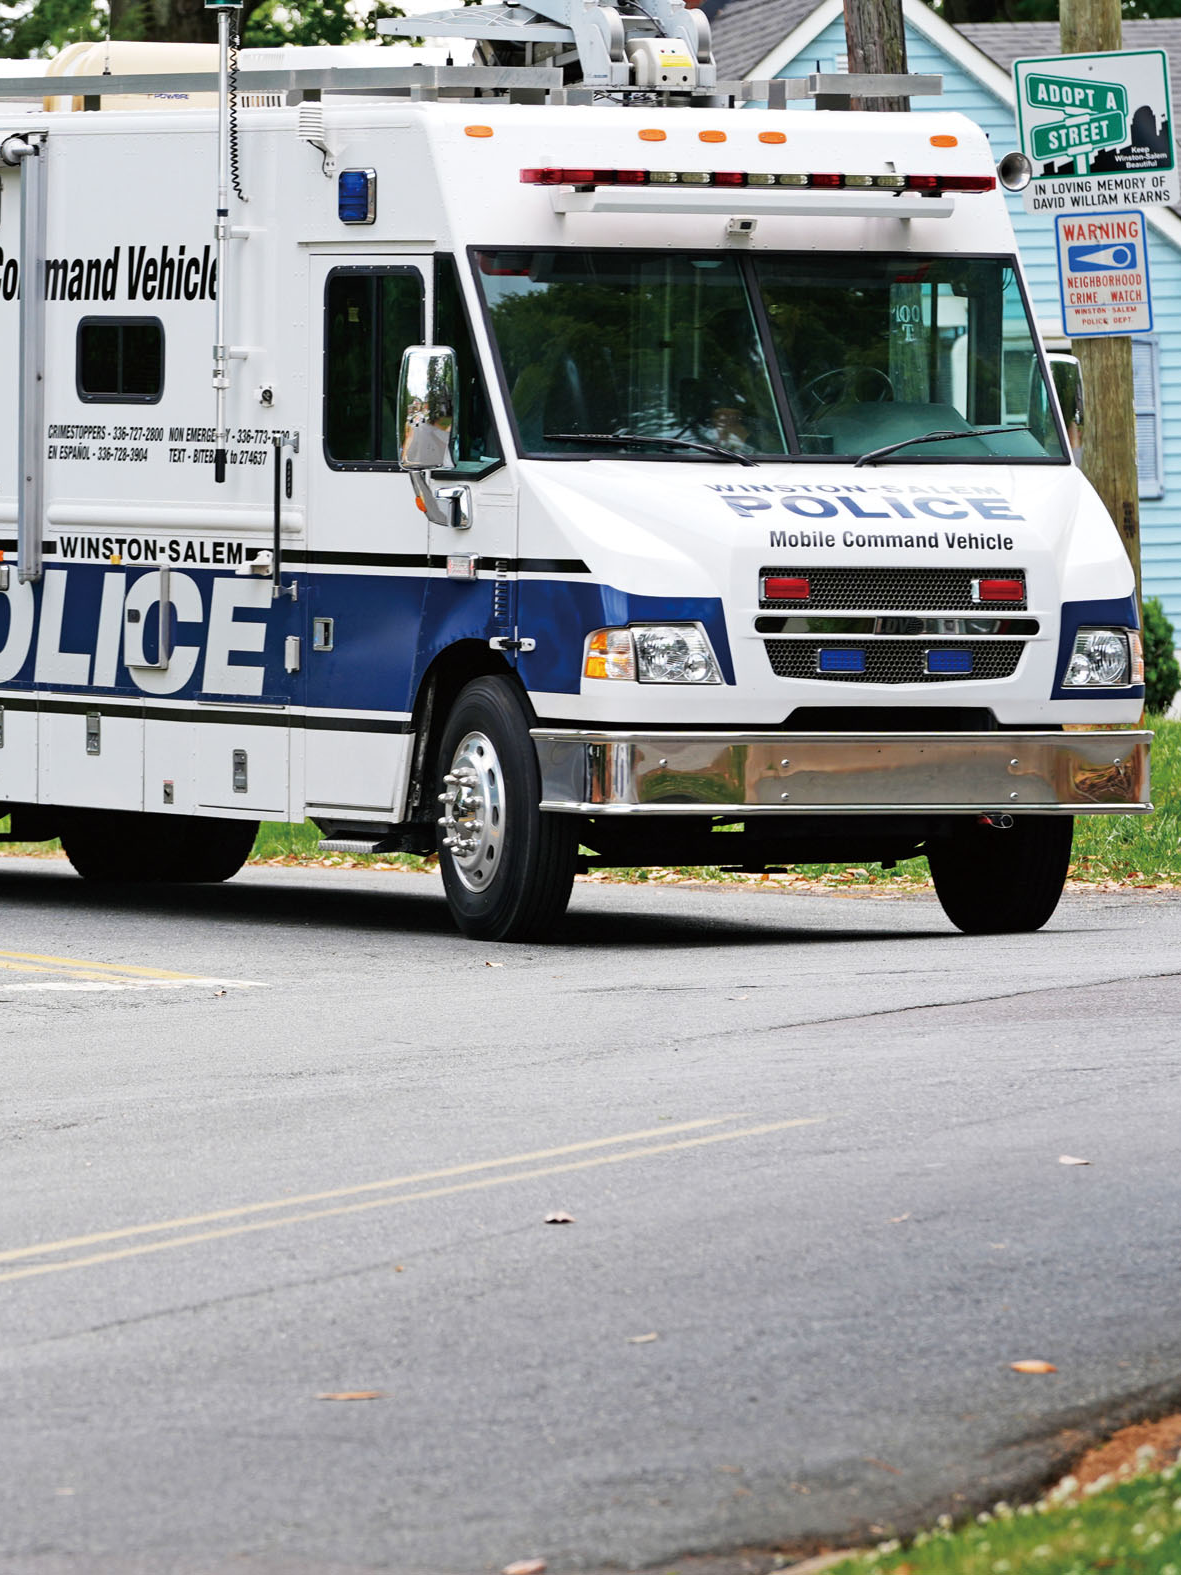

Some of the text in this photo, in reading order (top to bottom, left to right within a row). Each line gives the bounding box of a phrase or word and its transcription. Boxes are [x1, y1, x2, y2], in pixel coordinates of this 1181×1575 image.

[1038, 83, 1117, 110] ADOPT A
[1048, 120, 1109, 149] STREET
[1115, 153, 1167, 162] Winston-Salem
[1131, 146, 1150, 154] Keep
[1126, 160, 1158, 169] Beautiful
[1035, 176, 1166, 195] IN LOVING MEMORY OF
[1033, 190, 1171, 210] DAVID WILLIAM KEARNS
[1063, 221, 1139, 241] WARNING
[1067, 274, 1142, 289] NEIGHBORHOOD
[1070, 289, 1142, 304] CRIME WATCH
[1074, 307, 1107, 315] WINSTON
[1082, 317, 1109, 326] POLICE
[48, 424, 106, 439] CRIMESTOPPERS
[112, 426, 164, 441] 336-727-2800
[169, 427, 185, 442] NON
[186, 427, 231, 443] EMERGEY
[48, 445, 58, 459] EN
[59, 442, 90, 460] ESPAÑOL
[97, 446, 148, 461] 336-728-3904
[169, 448, 186, 463] TEXT
[230, 450, 238, 465] to
[239, 450, 267, 465] 274637
[702, 484, 1002, 496] WINSTON-SALEM
[720, 495, 1026, 521] POLICE
[769, 530, 1014, 550] Mobile Command Vehicle
[59, 535, 243, 565] WINSTON-SALEM
